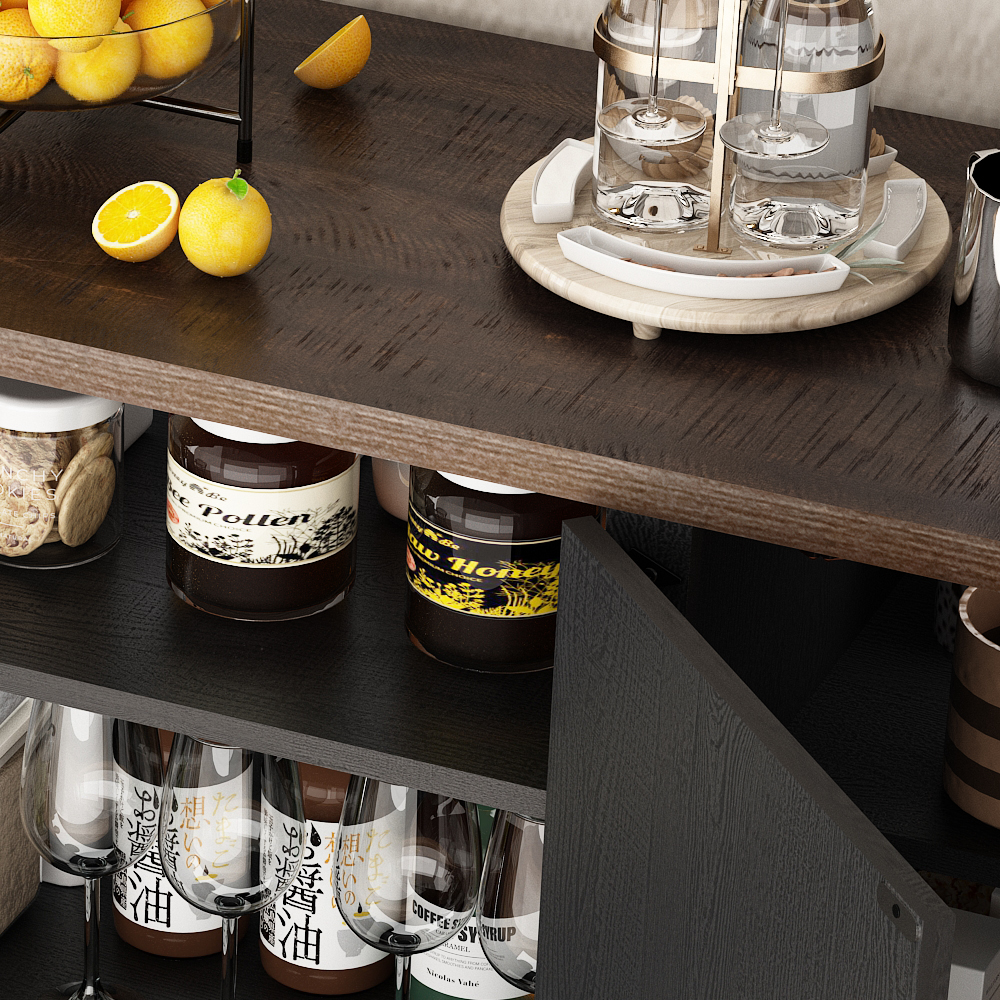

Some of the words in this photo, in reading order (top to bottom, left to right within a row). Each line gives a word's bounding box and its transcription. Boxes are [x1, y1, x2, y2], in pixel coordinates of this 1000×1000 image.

[198, 503, 311, 527] Pollen
[408, 522, 440, 561] aw
[412, 899, 451, 930] COFFEE
[426, 967, 456, 983] Nicolas
[457, 978, 480, 987] Vahé
